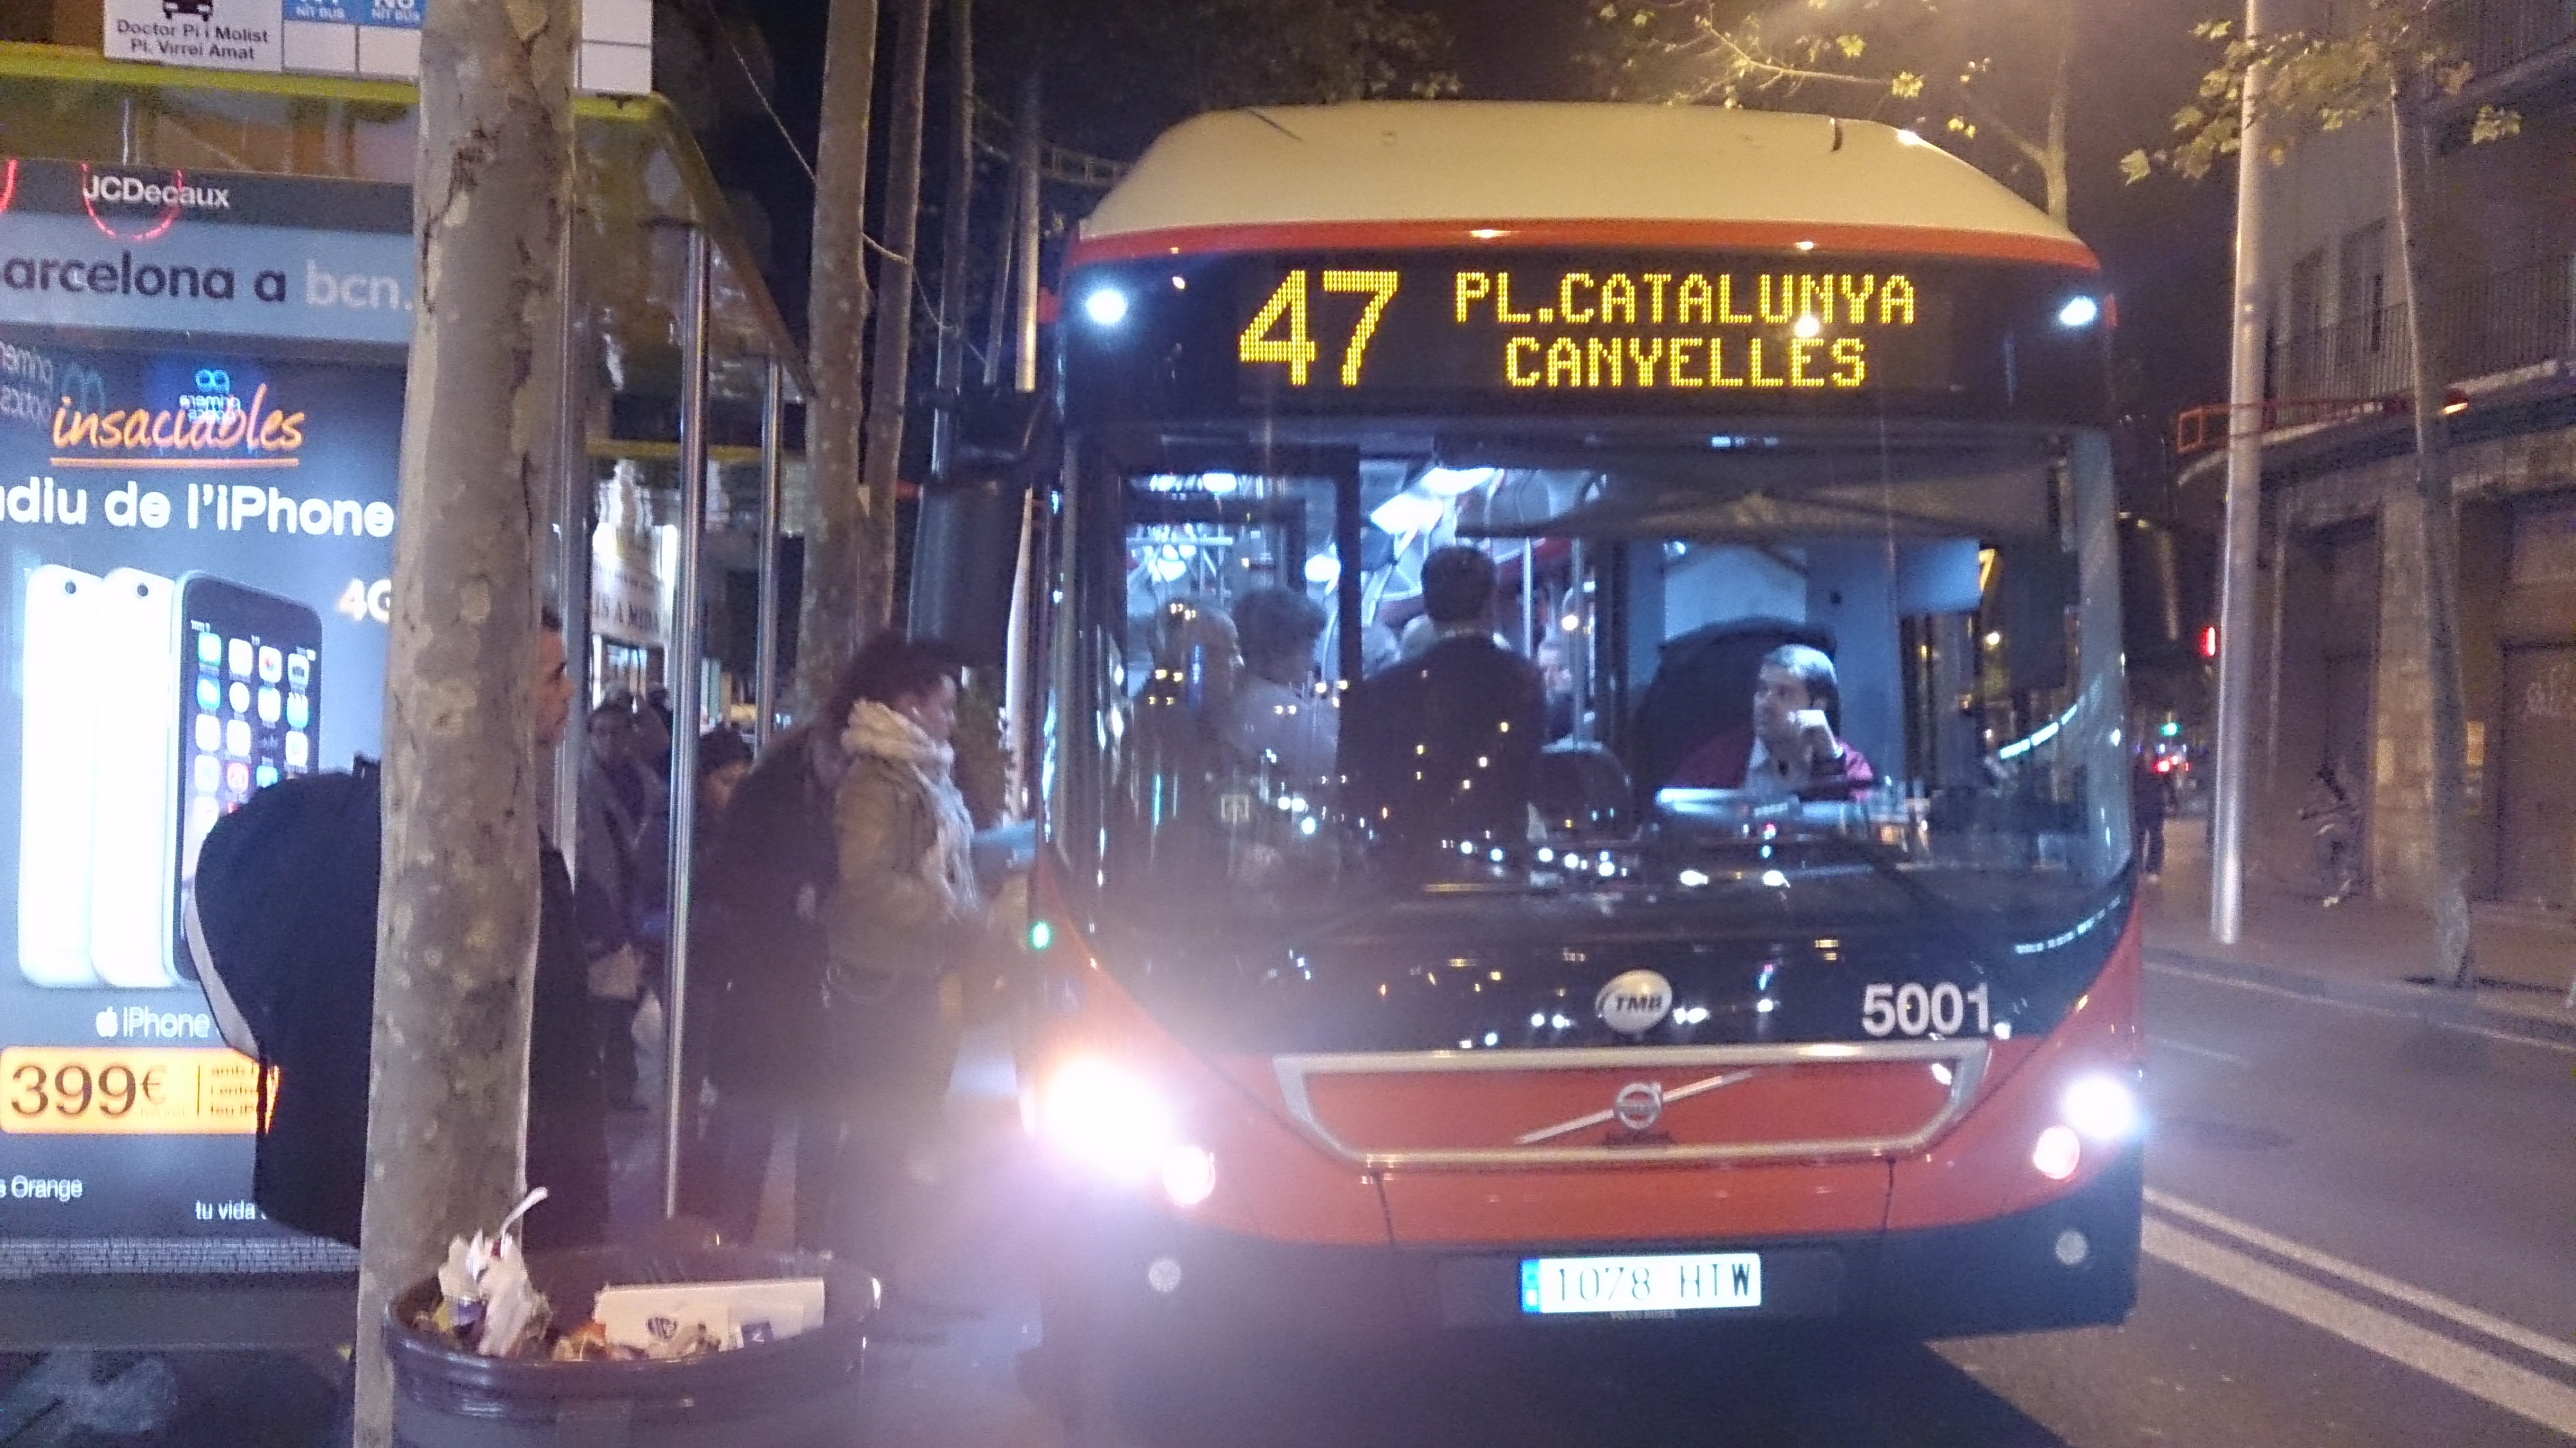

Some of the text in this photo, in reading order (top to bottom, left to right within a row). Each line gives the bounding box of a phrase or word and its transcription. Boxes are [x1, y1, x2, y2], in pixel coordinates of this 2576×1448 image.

[117, 19, 175, 35] Doctor
[183, 24, 199, 37] Pi
[216, 26, 268, 43] Molist
[157, 39, 203, 55] Virrei
[209, 43, 254, 59] Amat
[83, 175, 229, 208] JCDecaux
[254, 269, 287, 302] a
[1238, 269, 1915, 386] 47 PL.CATALUNYA
[1506, 336, 1867, 388] CANYELLES
[53, 382, 306, 451] insaciables
[104, 480, 171, 528] de
[1617, 995, 1663, 1012] TMB
[1862, 981, 1989, 1037] 5001
[123, 1005, 210, 1038] iPhone
[10, 1063, 168, 1118] 399€
[11, 1175, 83, 1202] Orange
[196, 1200, 213, 1220] tu
[218, 1199, 255, 1220] vida
[1558, 1263, 1751, 1301] 1078 HTW
